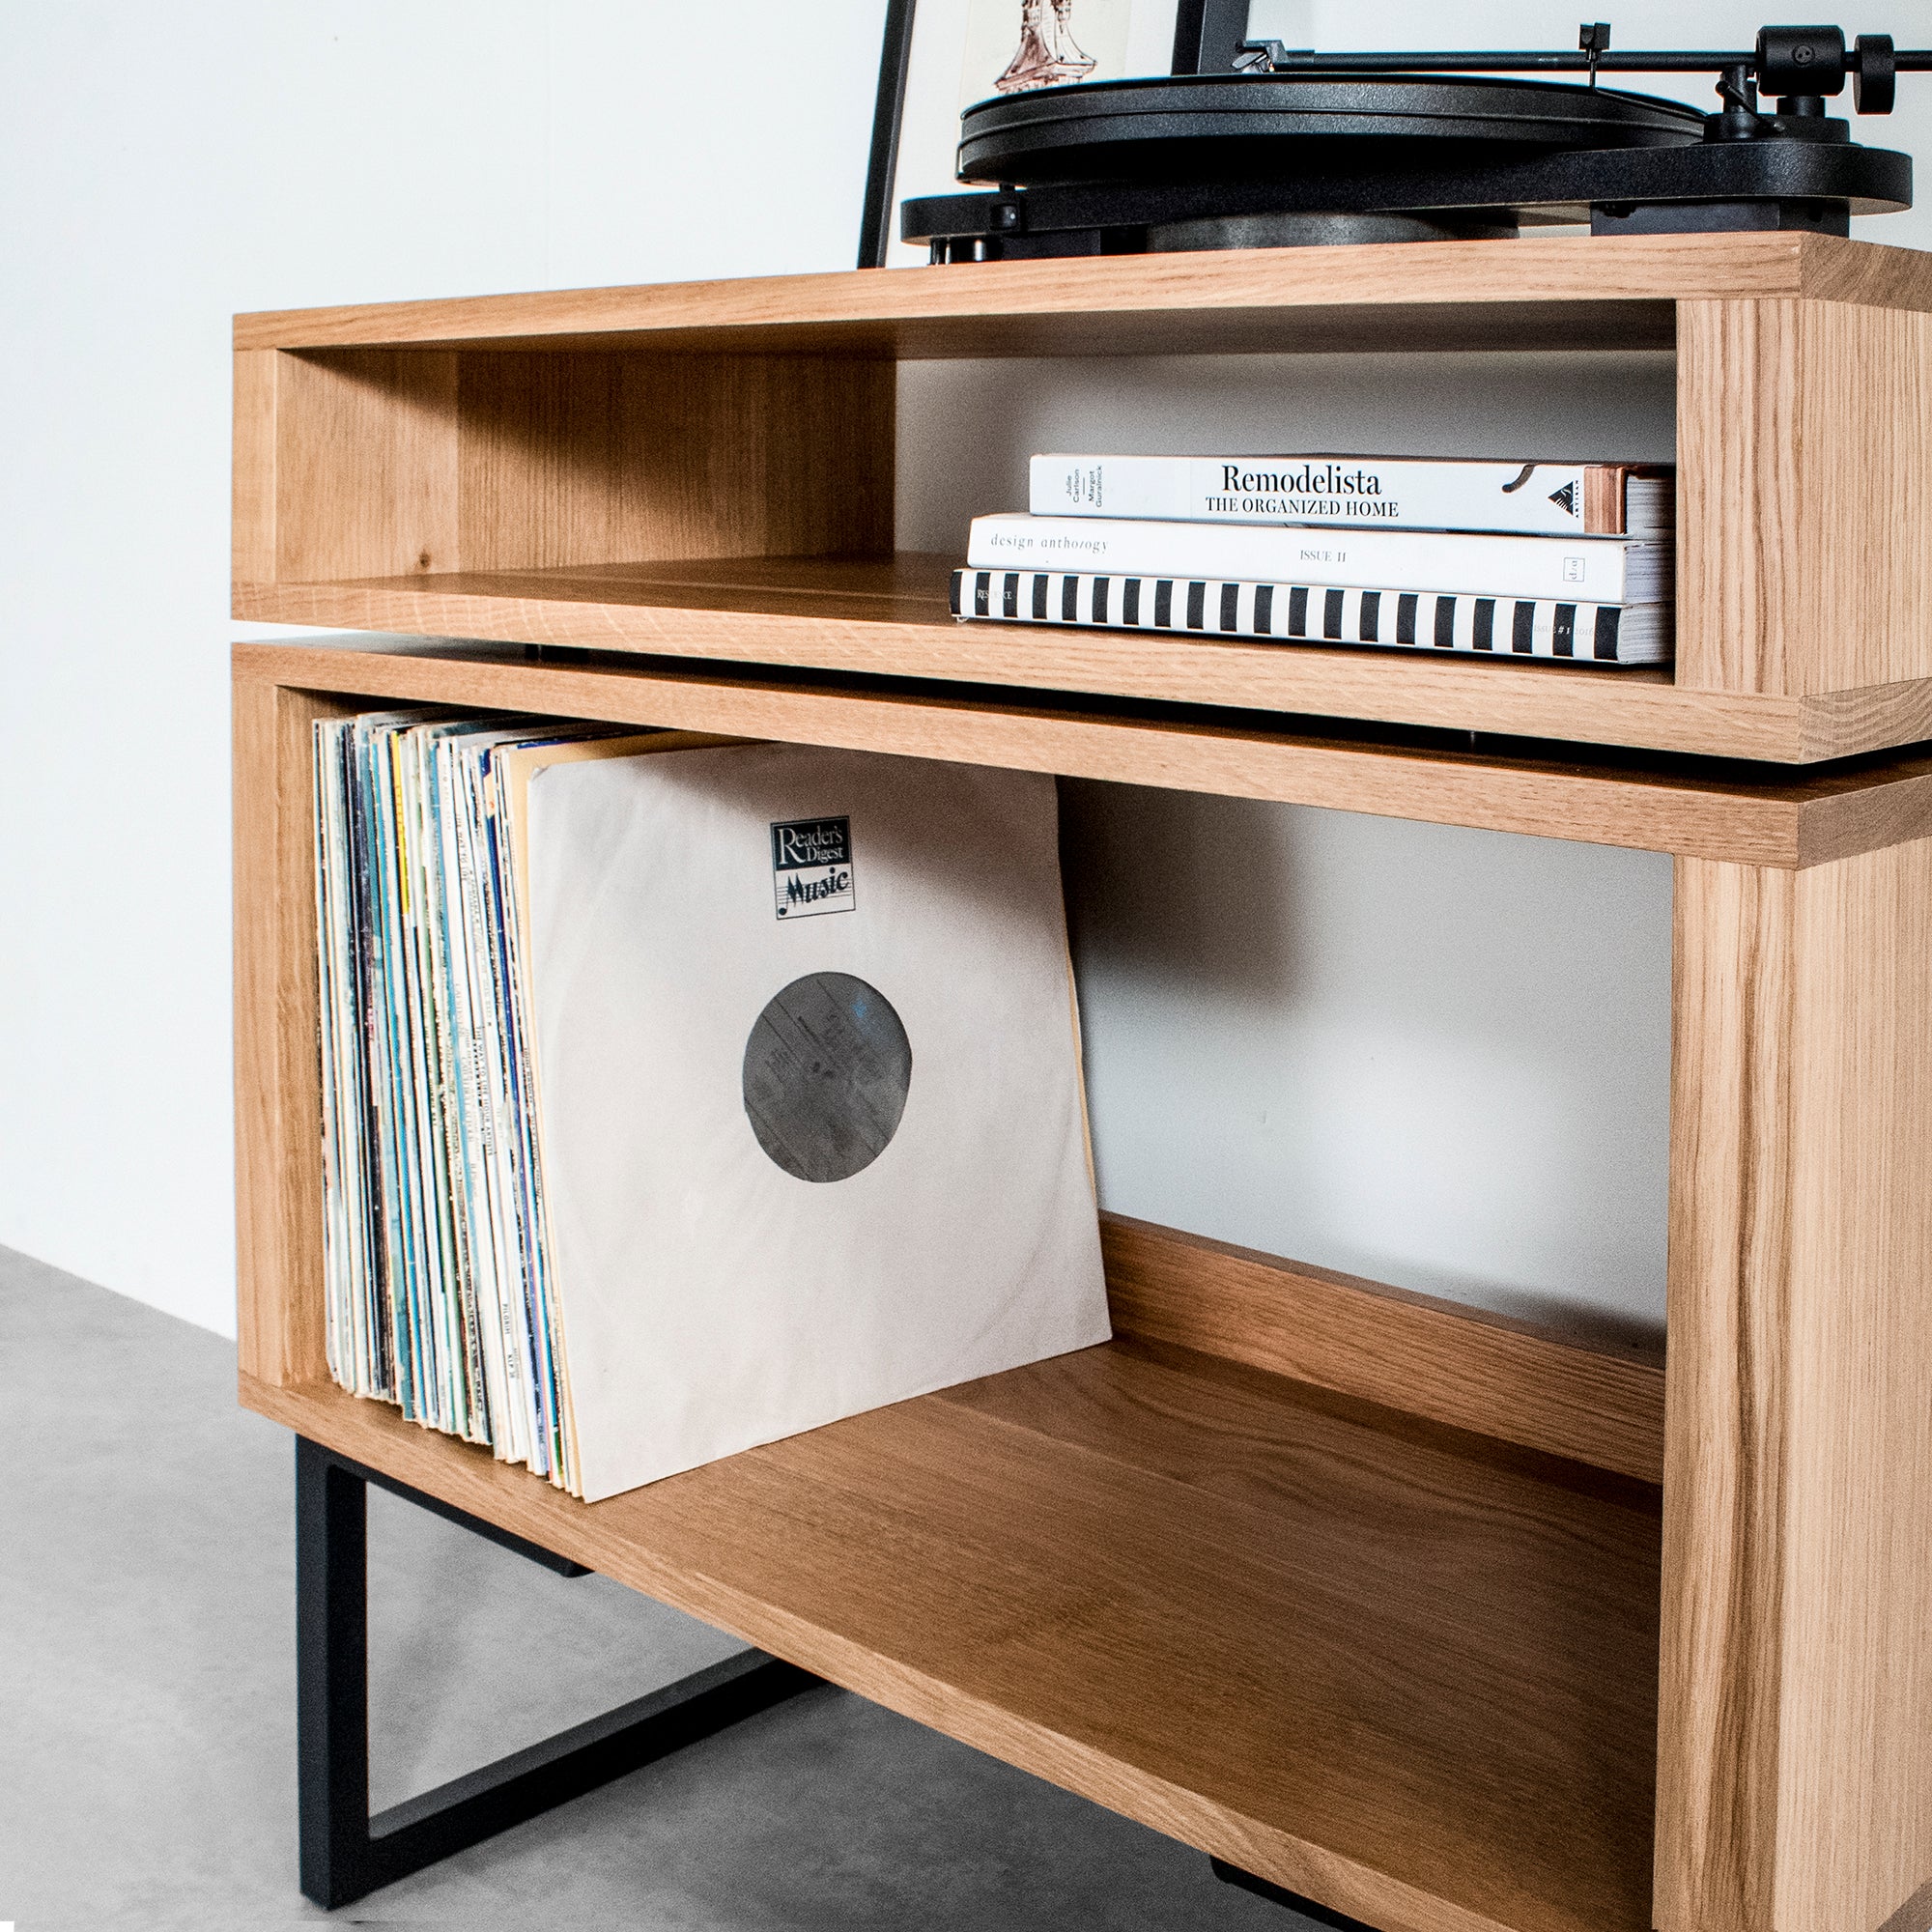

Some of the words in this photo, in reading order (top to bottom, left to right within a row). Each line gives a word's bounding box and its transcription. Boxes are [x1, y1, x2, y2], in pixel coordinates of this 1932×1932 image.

[1221, 465, 1382, 496] Remodelista
[1206, 497, 1238, 513] THE
[1242, 497, 1341, 516] ORGANIZED
[1346, 500, 1400, 518] HOME
[990, 533, 1034, 551] design
[1040, 536, 1109, 555] anthology
[1300, 550, 1332, 561] ISSUE
[779, 825, 842, 864] Reader's
[807, 846, 843, 863] Digest
[779, 867, 850, 916] Music
[477, 1043, 487, 1062] WAY
[483, 1099, 492, 1122] HOUR
[485, 1126, 495, 1156] ARTISTS
[501, 1303, 512, 1335] PILGRIM
